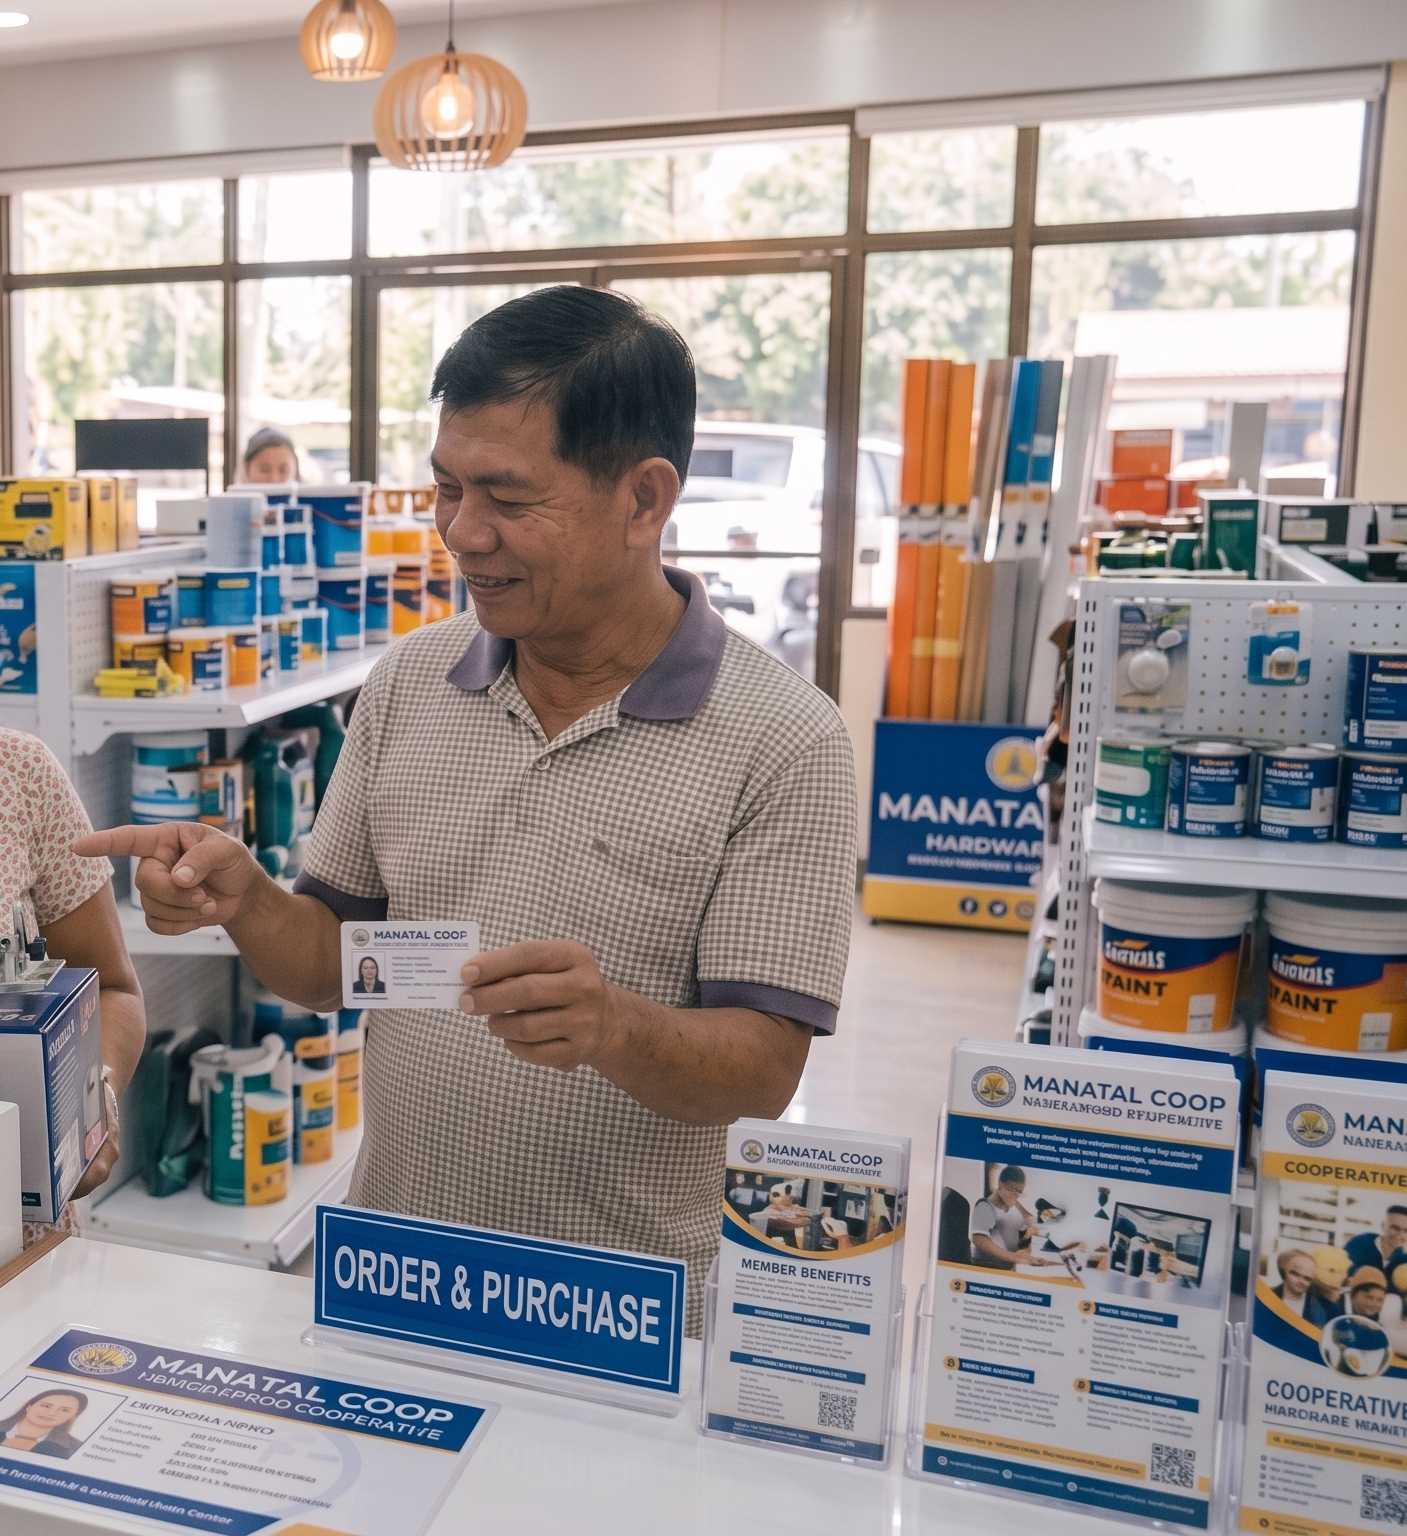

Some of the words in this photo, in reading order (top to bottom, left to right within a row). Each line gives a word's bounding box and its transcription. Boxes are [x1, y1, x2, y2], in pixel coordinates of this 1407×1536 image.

[878, 791, 1044, 831] MANATA
[925, 832, 1044, 859] HARDWAR
[374, 930, 431, 940] MANATAL
[434, 930, 468, 940] COOP
[1023, 1074, 1143, 1105] MANATAL
[1150, 1089, 1227, 1113] COOP
[1344, 1111, 1407, 1136] MAN
[768, 1143, 836, 1163] MANATAL
[840, 1152, 883, 1167] COOP
[1284, 1160, 1407, 1188] COOPERATIVE
[741, 1258, 797, 1277] MEMBER
[334, 1244, 441, 1306] ORDER
[450, 1264, 472, 1311] &
[482, 1270, 660, 1345] PURCHASE
[148, 1355, 326, 1404] MANATAL
[338, 1392, 454, 1424] COOP
[1266, 1379, 1407, 1421] COOPERATIVE
